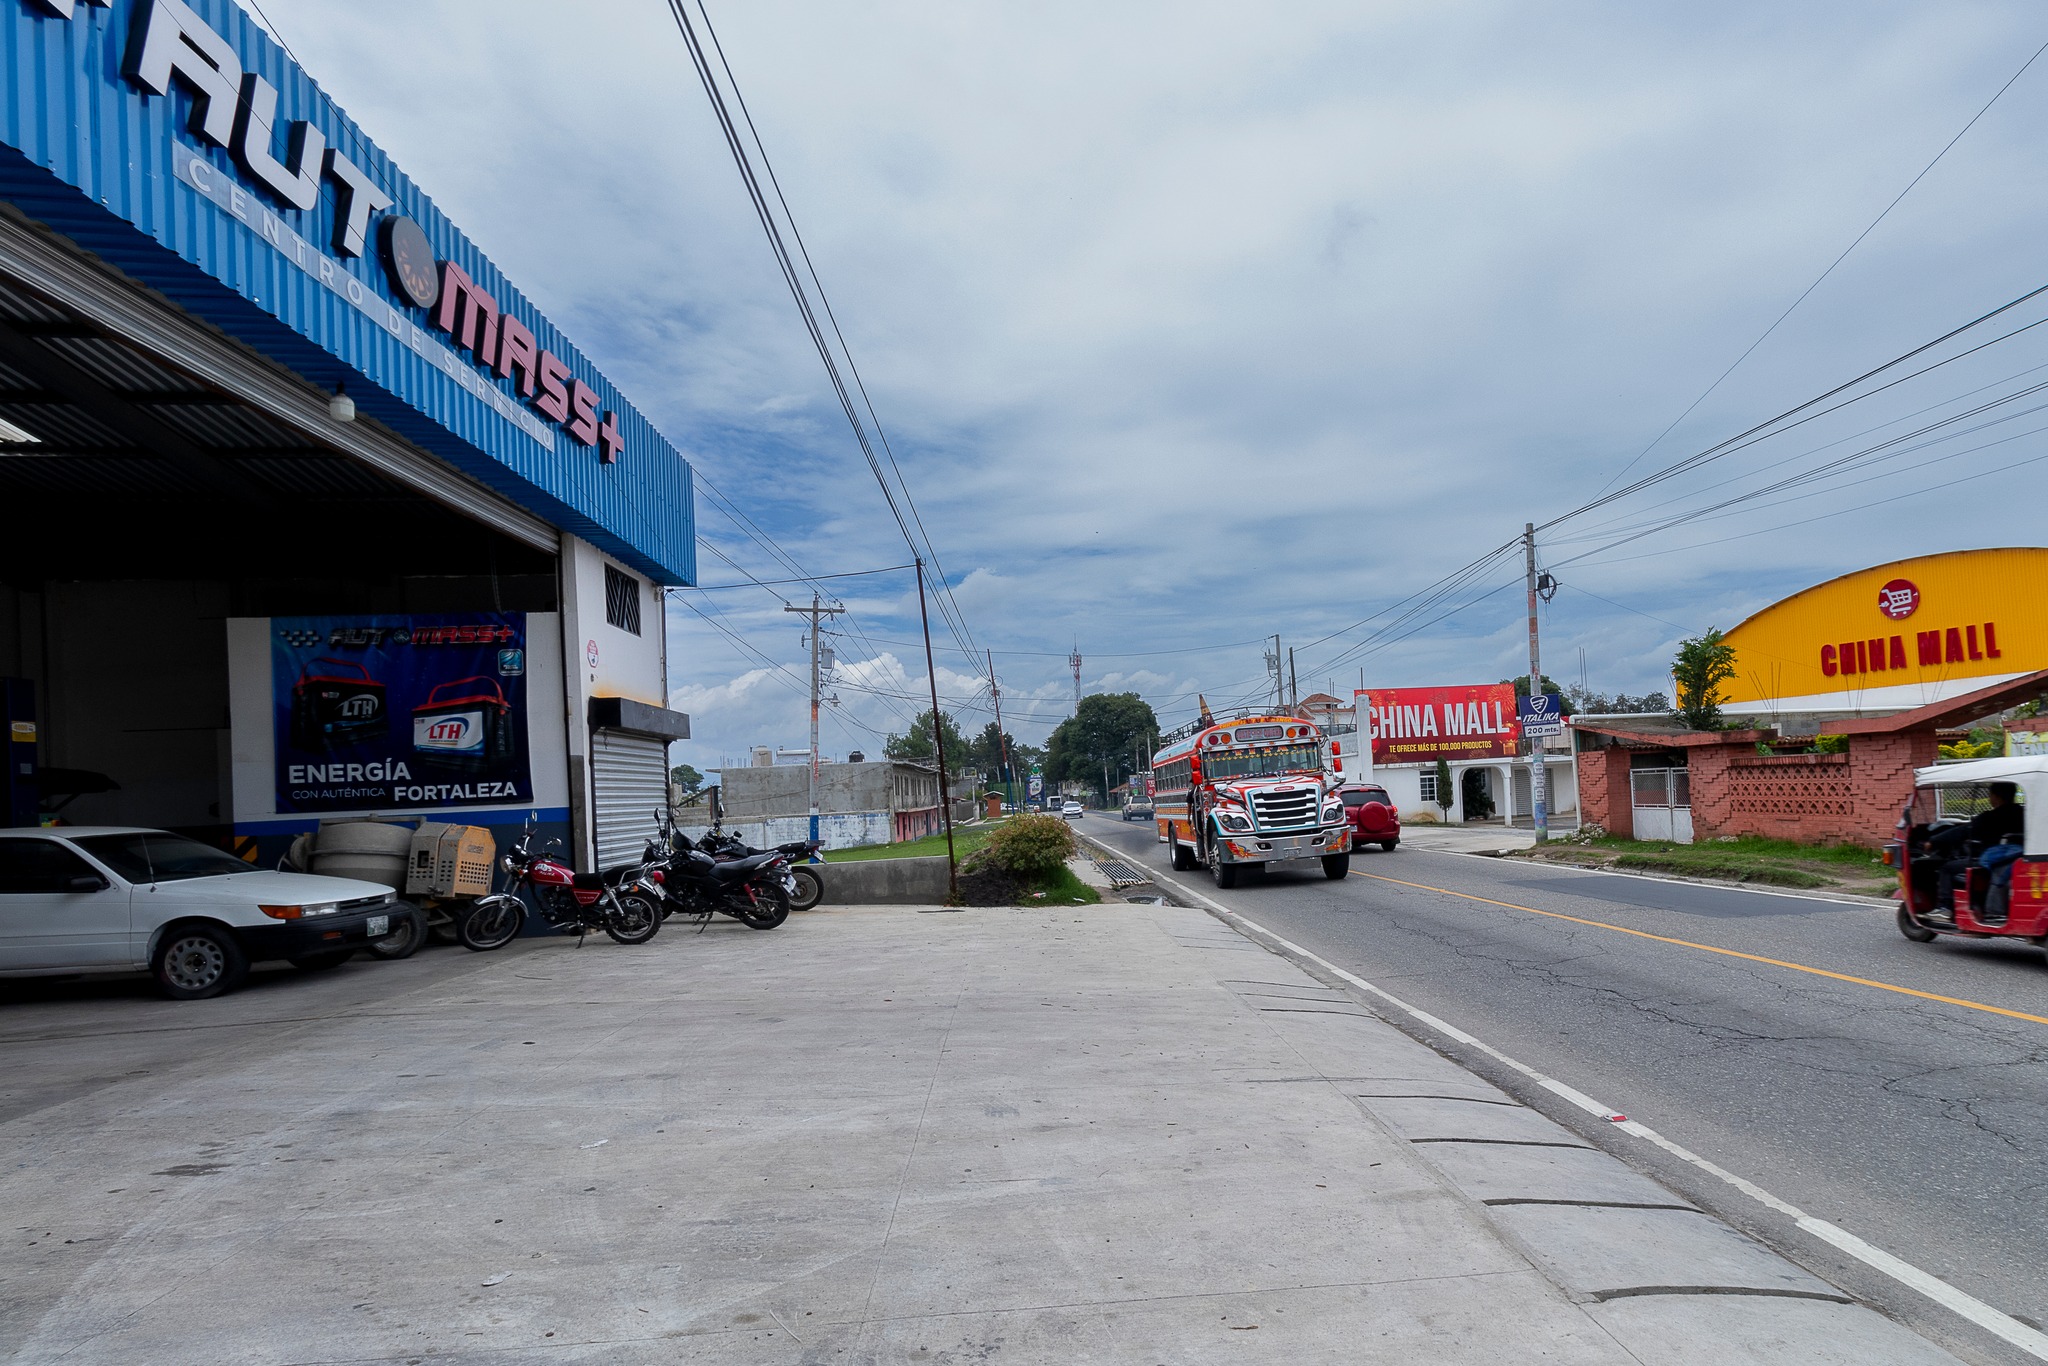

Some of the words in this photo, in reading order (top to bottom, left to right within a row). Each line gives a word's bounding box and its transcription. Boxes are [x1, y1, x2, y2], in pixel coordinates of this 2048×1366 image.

[188, 157, 364, 306] CENTRO
[387, 310, 424, 352] DE
[443, 351, 553, 447] SERVICIO
[1820, 635, 1907, 677] CHINA
[1917, 622, 2002, 667] MALL
[342, 700, 373, 716] LTH
[1444, 701, 1510, 736] MALL
[1522, 712, 1560, 723] ITALIKA
[429, 724, 462, 739] LTH
[1527, 727, 1543, 735] 200
[1545, 726, 1559, 734] mts.
[1389, 745, 1396, 753] TE
[1397, 744, 1417, 753] OFRECE
[1417, 742, 1429, 752] MÁS
[1430, 743, 1438, 752] DE
[1438, 742, 1461, 751] 100,000
[1461, 740, 1492, 750] PRODUCTOS
[289, 758, 411, 784] ENERGÍA
[292, 789, 319, 799] CON
[321, 786, 386, 799] AUTÉNTICA
[394, 782, 518, 802] FORTALEZA
